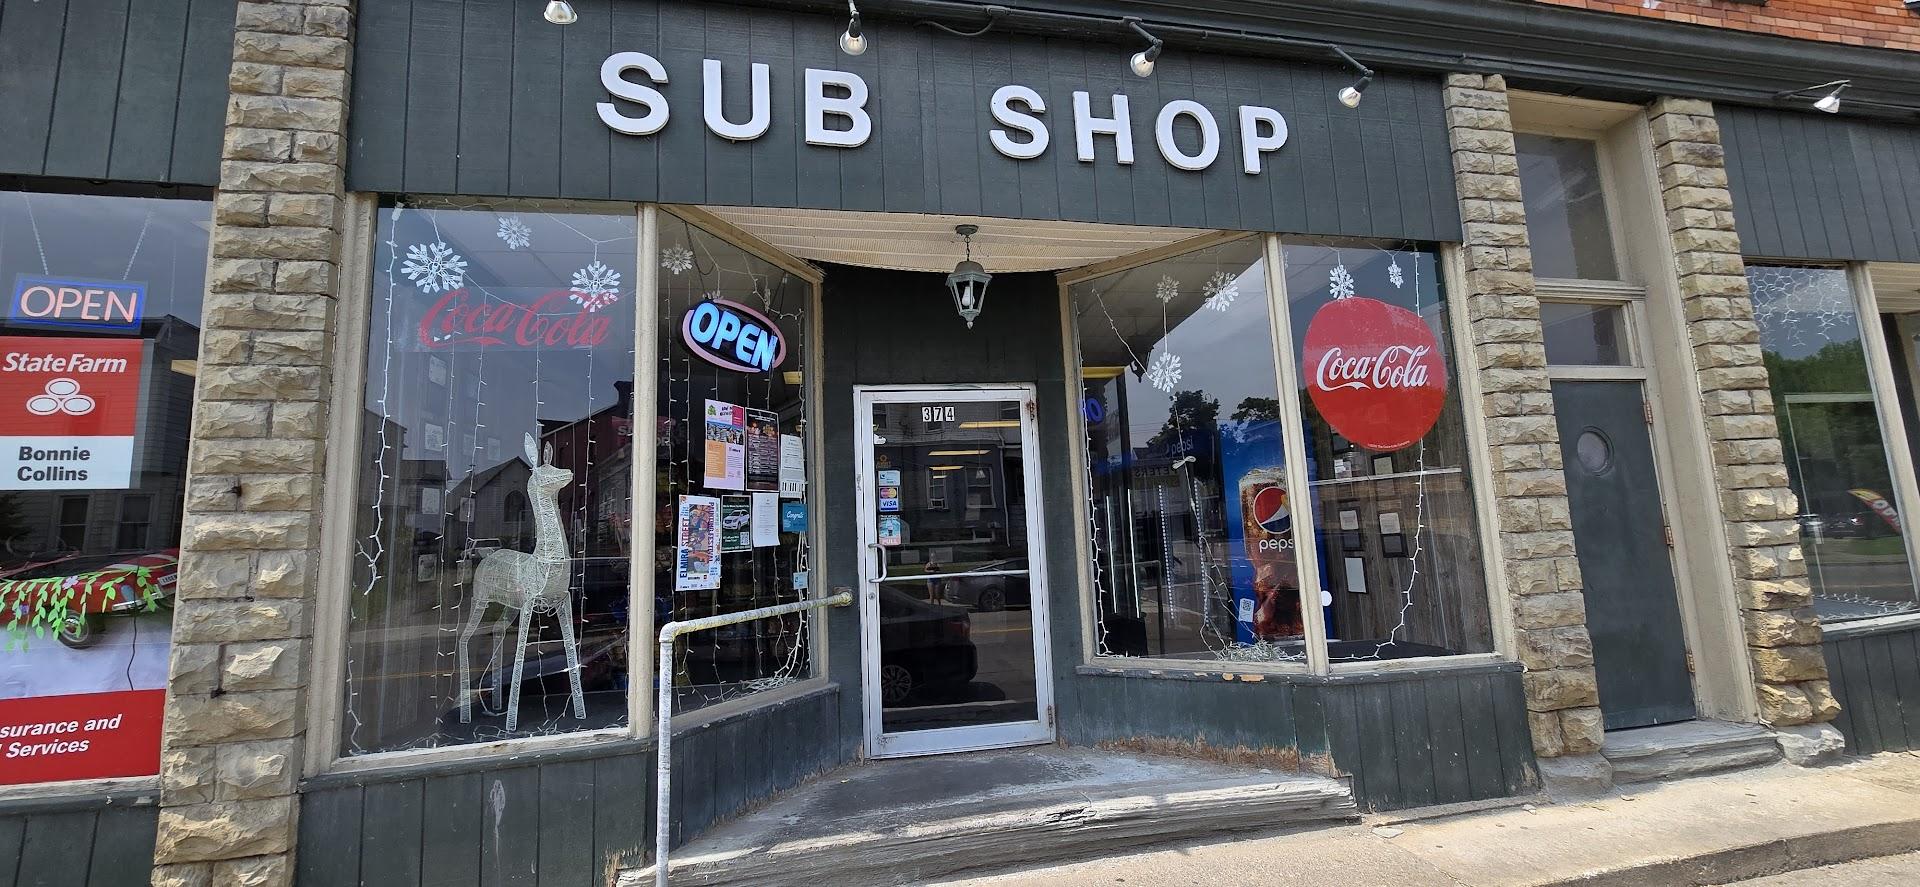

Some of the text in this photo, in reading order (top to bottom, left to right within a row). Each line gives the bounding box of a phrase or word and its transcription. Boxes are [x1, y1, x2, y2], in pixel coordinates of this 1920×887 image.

[596, 51, 1288, 174] SUB SHOP
[20, 286, 137, 323] OPEN
[690, 302, 778, 372] OPEN
[1316, 345, 1431, 391] Coca-Cola
[923, 406, 954, 421] 374
[18, 446, 91, 461] Bonnie
[17, 466, 88, 481] Collins
[680, 548, 688, 578] ELMIRA
[84, 713, 122, 734] and
[6, 739, 90, 758] Services
